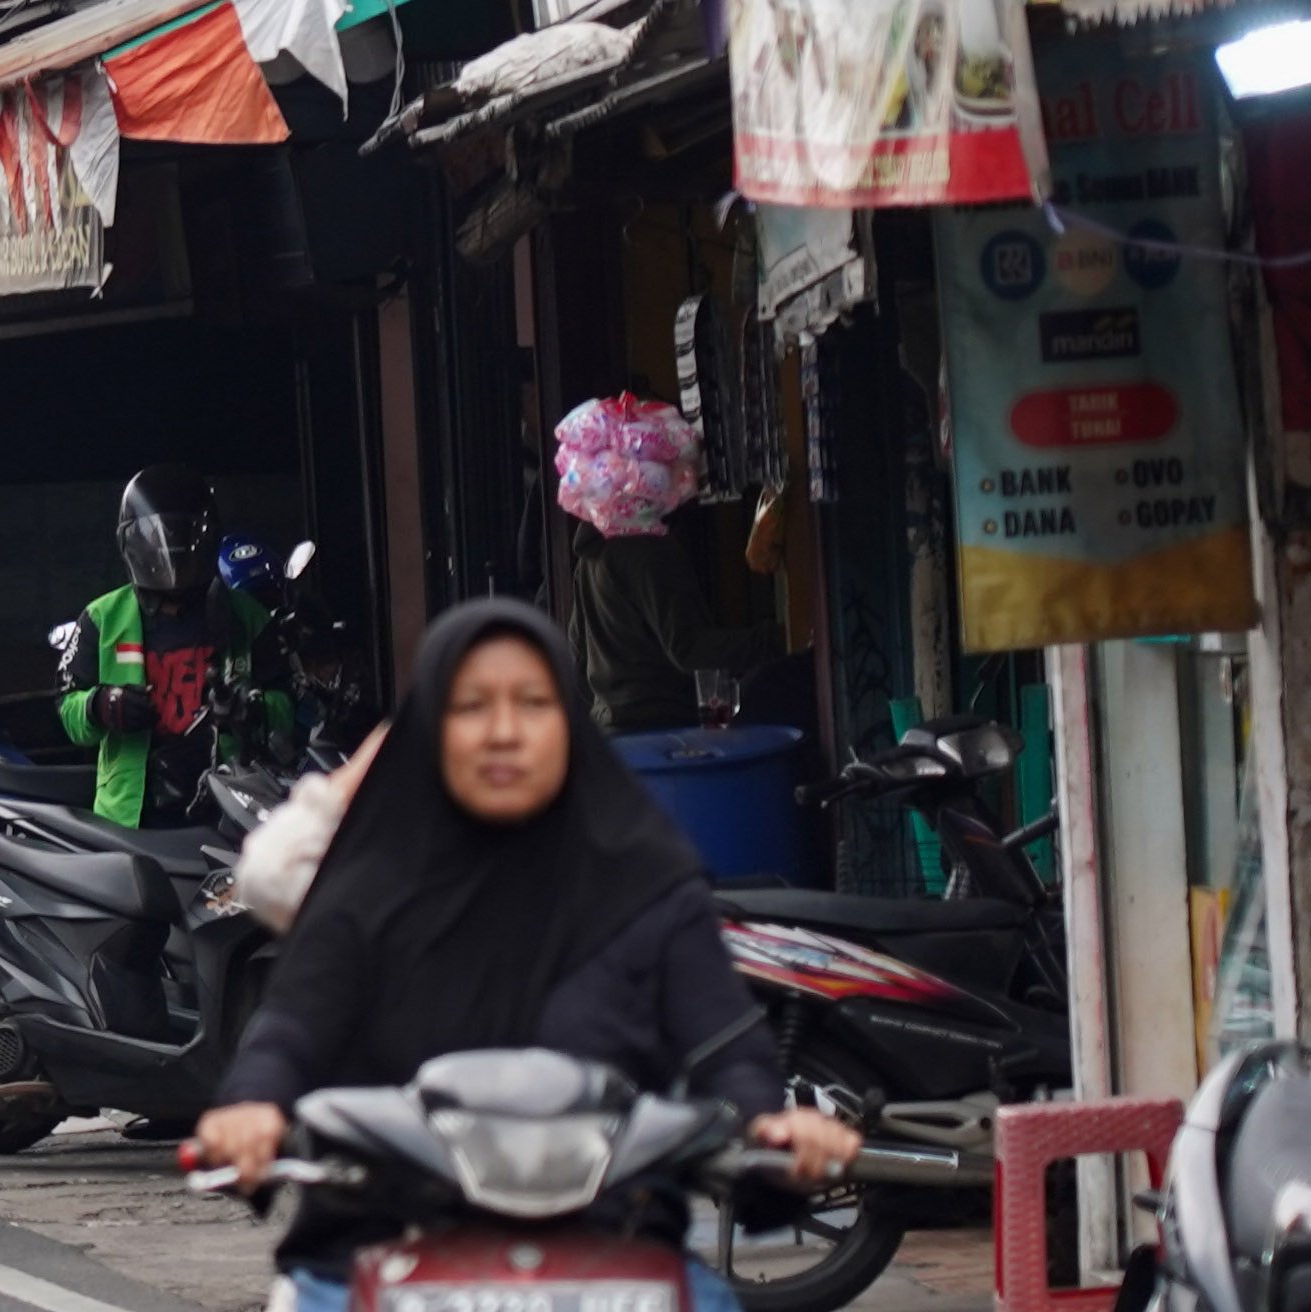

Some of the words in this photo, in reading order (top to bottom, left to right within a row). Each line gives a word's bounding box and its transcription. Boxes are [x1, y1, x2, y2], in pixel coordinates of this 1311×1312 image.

[1000, 465, 1072, 498] BANK
[1132, 457, 1184, 487] OVO
[1004, 505, 1076, 539] DANA
[1136, 494, 1217, 529] GOPAY
